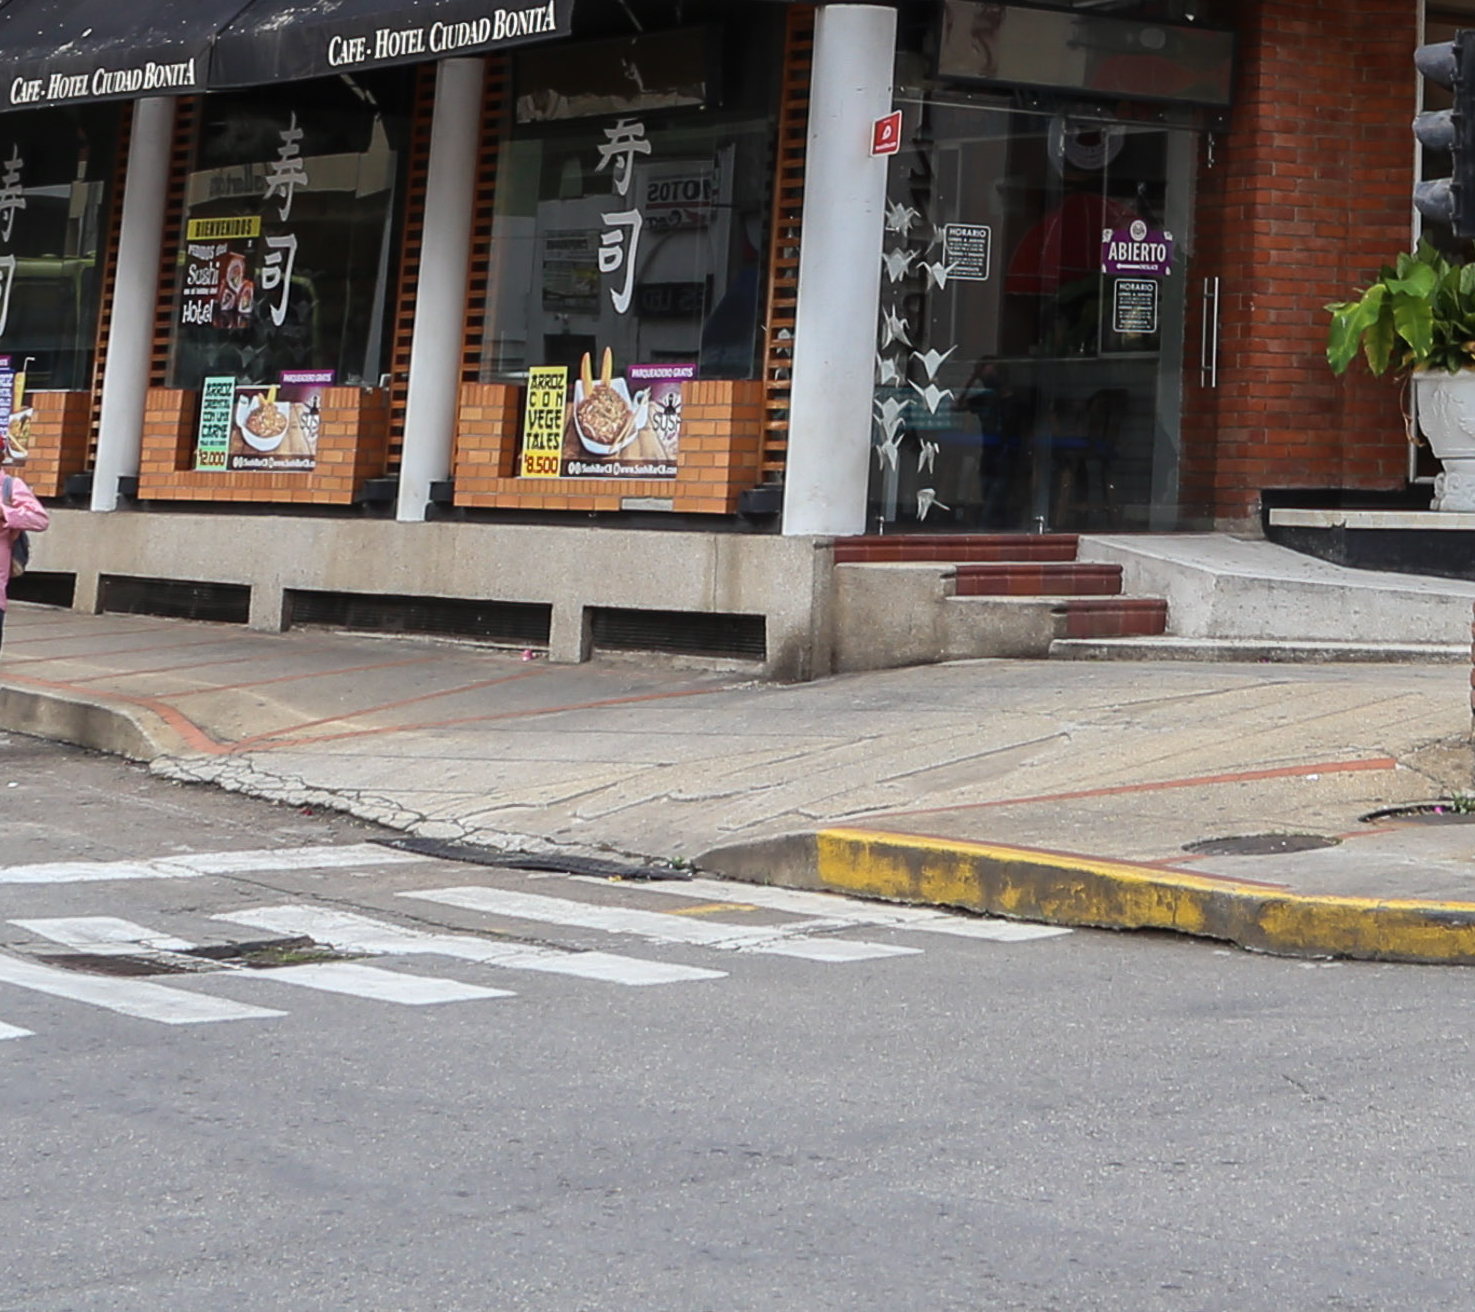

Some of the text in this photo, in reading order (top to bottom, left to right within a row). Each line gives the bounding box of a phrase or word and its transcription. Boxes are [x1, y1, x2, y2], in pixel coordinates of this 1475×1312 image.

[374, 28, 425, 59] HOTEL
[429, 17, 491, 53] CIUDAD
[492, 0, 556, 41] BONITA
[46, 73, 88, 101] HOTEL
[91, 67, 142, 97] CIUDAD
[143, 58, 195, 89] BONITA
[949, 228, 986, 237] HORARIO
[1108, 242, 1167, 262] ABIERTO
[187, 261, 221, 286] Sushi
[1119, 283, 1154, 291] HORARIO
[182, 298, 214, 325] Hotel
[530, 373, 564, 391] ARROZ
[529, 391, 563, 407] CON
[528, 409, 561, 429] VEGE
[526, 432, 560, 450] TALES
